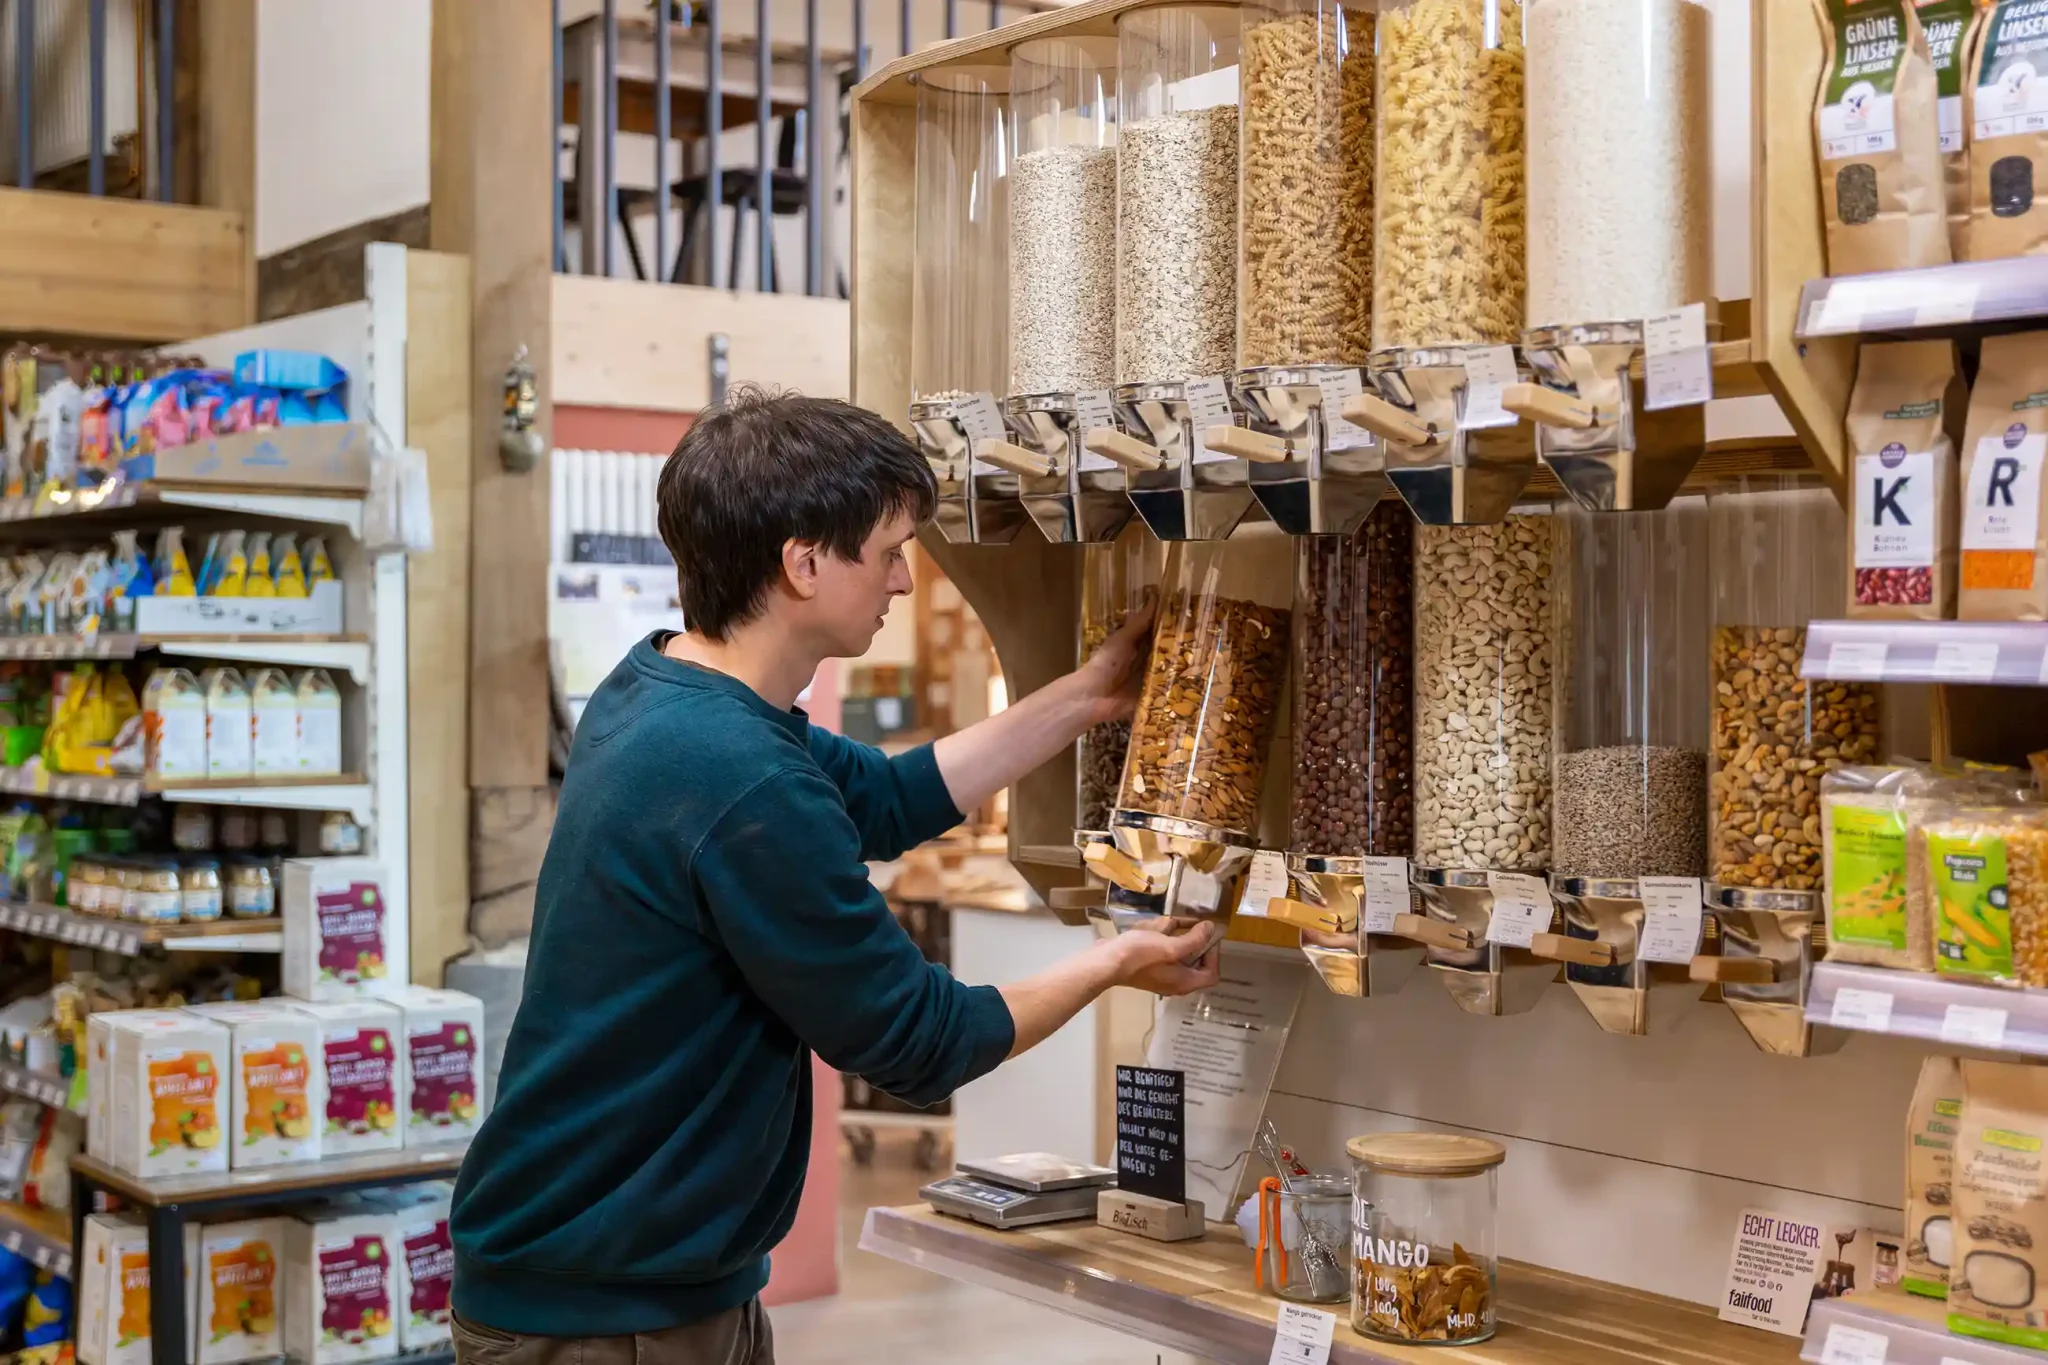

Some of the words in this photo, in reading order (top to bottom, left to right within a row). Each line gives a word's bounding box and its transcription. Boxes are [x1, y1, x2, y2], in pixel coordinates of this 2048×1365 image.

[1845, 16, 1898, 44] GRÜNE
[1844, 39, 1899, 65] LINSEN
[1986, 457, 2019, 507] R
[1873, 476, 1912, 527] K
[1117, 1101, 1131, 1116] DES
[1974, 1149, 2042, 1172] Parboiled
[1743, 1213, 1775, 1239] ECHT
[1776, 1220, 1821, 1249] LECKER.
[1353, 1230, 1430, 1268] MANGO
[1728, 1289, 1774, 1314] fairfood
